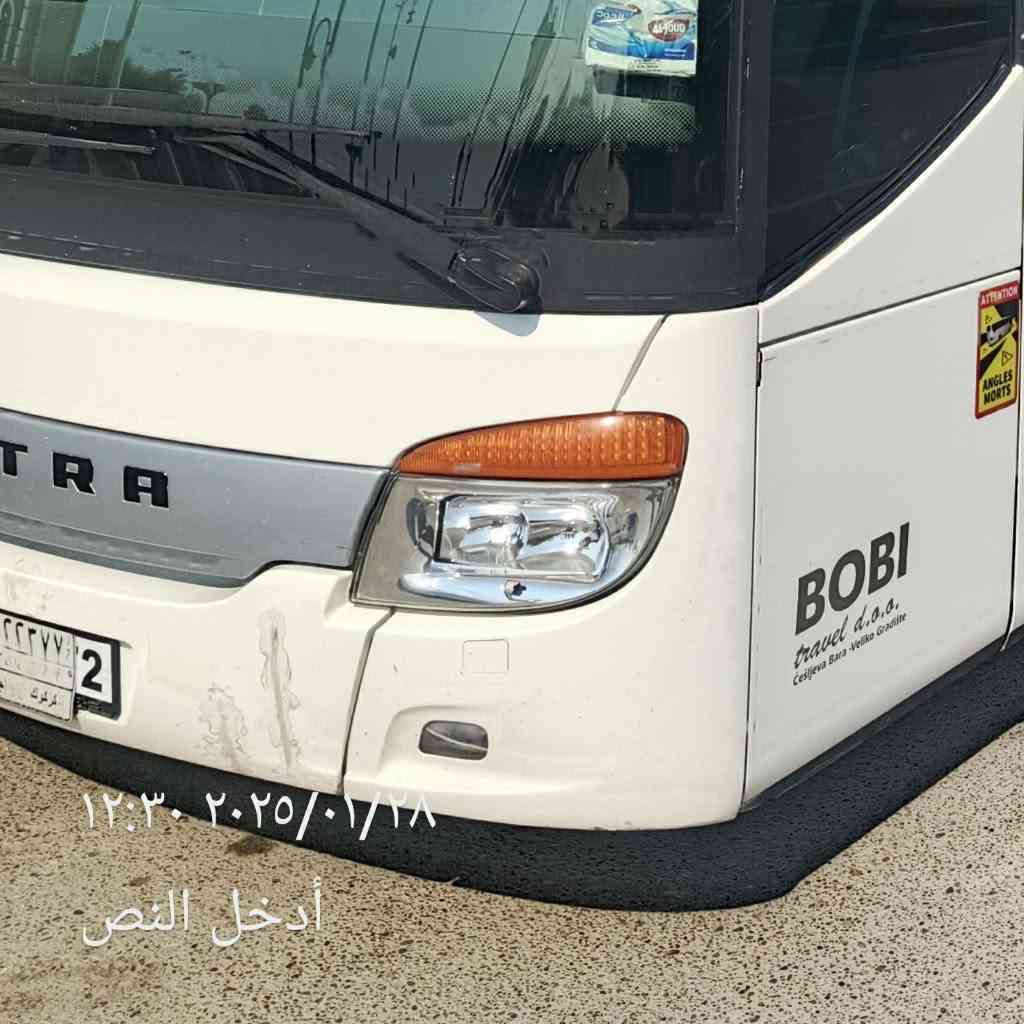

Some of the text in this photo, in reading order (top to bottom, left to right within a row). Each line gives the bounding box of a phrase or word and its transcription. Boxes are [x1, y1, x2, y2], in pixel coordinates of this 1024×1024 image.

[980, 285, 1019, 306] ATTENTION
[982, 368, 1014, 391] ANGLES
[983, 383, 1012, 405] MORTS
[795, 521, 910, 636] BOBI
[795, 614, 849, 670] travel
